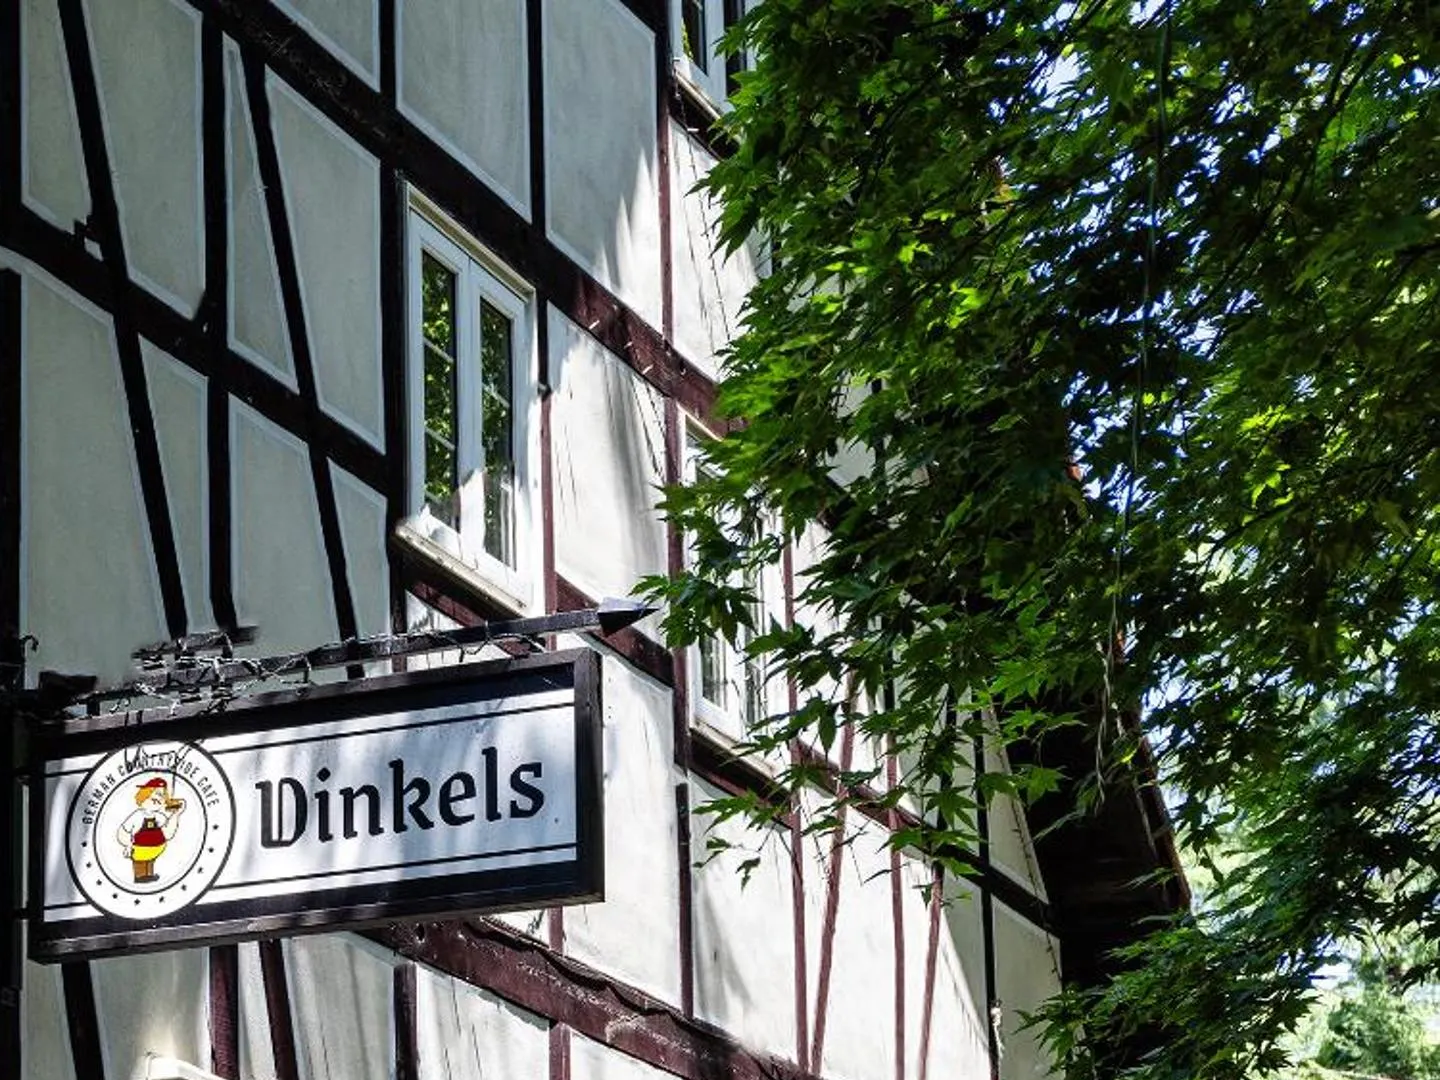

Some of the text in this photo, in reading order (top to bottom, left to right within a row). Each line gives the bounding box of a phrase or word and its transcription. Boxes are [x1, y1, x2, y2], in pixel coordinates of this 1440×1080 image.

[82, 773, 117, 825] GERMAN
[197, 776, 220, 808] CAFE
[255, 746, 545, 848] Dinkels
